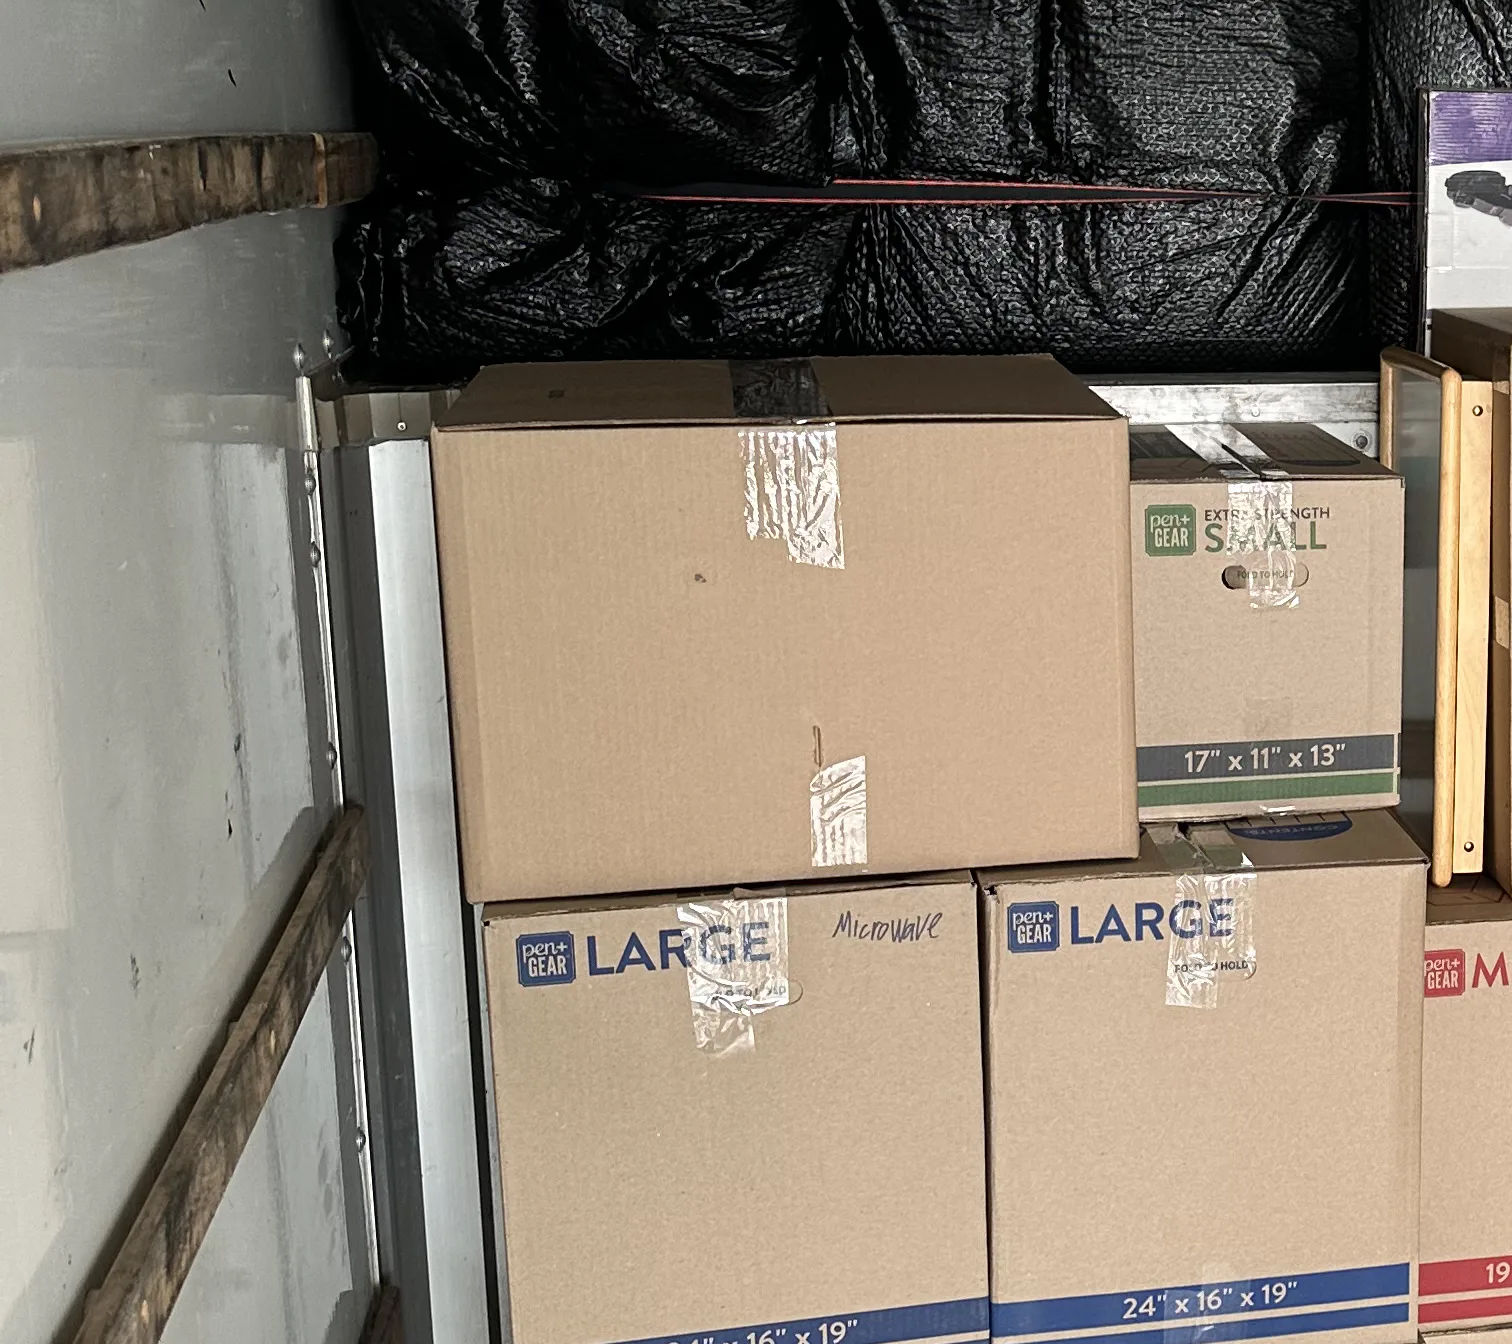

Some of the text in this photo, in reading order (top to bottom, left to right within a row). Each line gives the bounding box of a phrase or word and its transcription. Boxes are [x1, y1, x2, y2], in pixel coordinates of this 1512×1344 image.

[1154, 528, 1189, 548] GEAR
[1184, 742, 1347, 773] 17" x 11" x 13"
[1070, 898, 1234, 945] LARGE
[1017, 924, 1052, 944] GEAR
[587, 921, 772, 976] LARGE
[528, 955, 567, 977] GEAR
[1220, 960, 1249, 971] HOLD
[1427, 970, 1459, 989] GEAR
[1122, 1281, 1298, 1319] 24" x 16" x 19"
[818, 1319, 858, 1344] 19"
